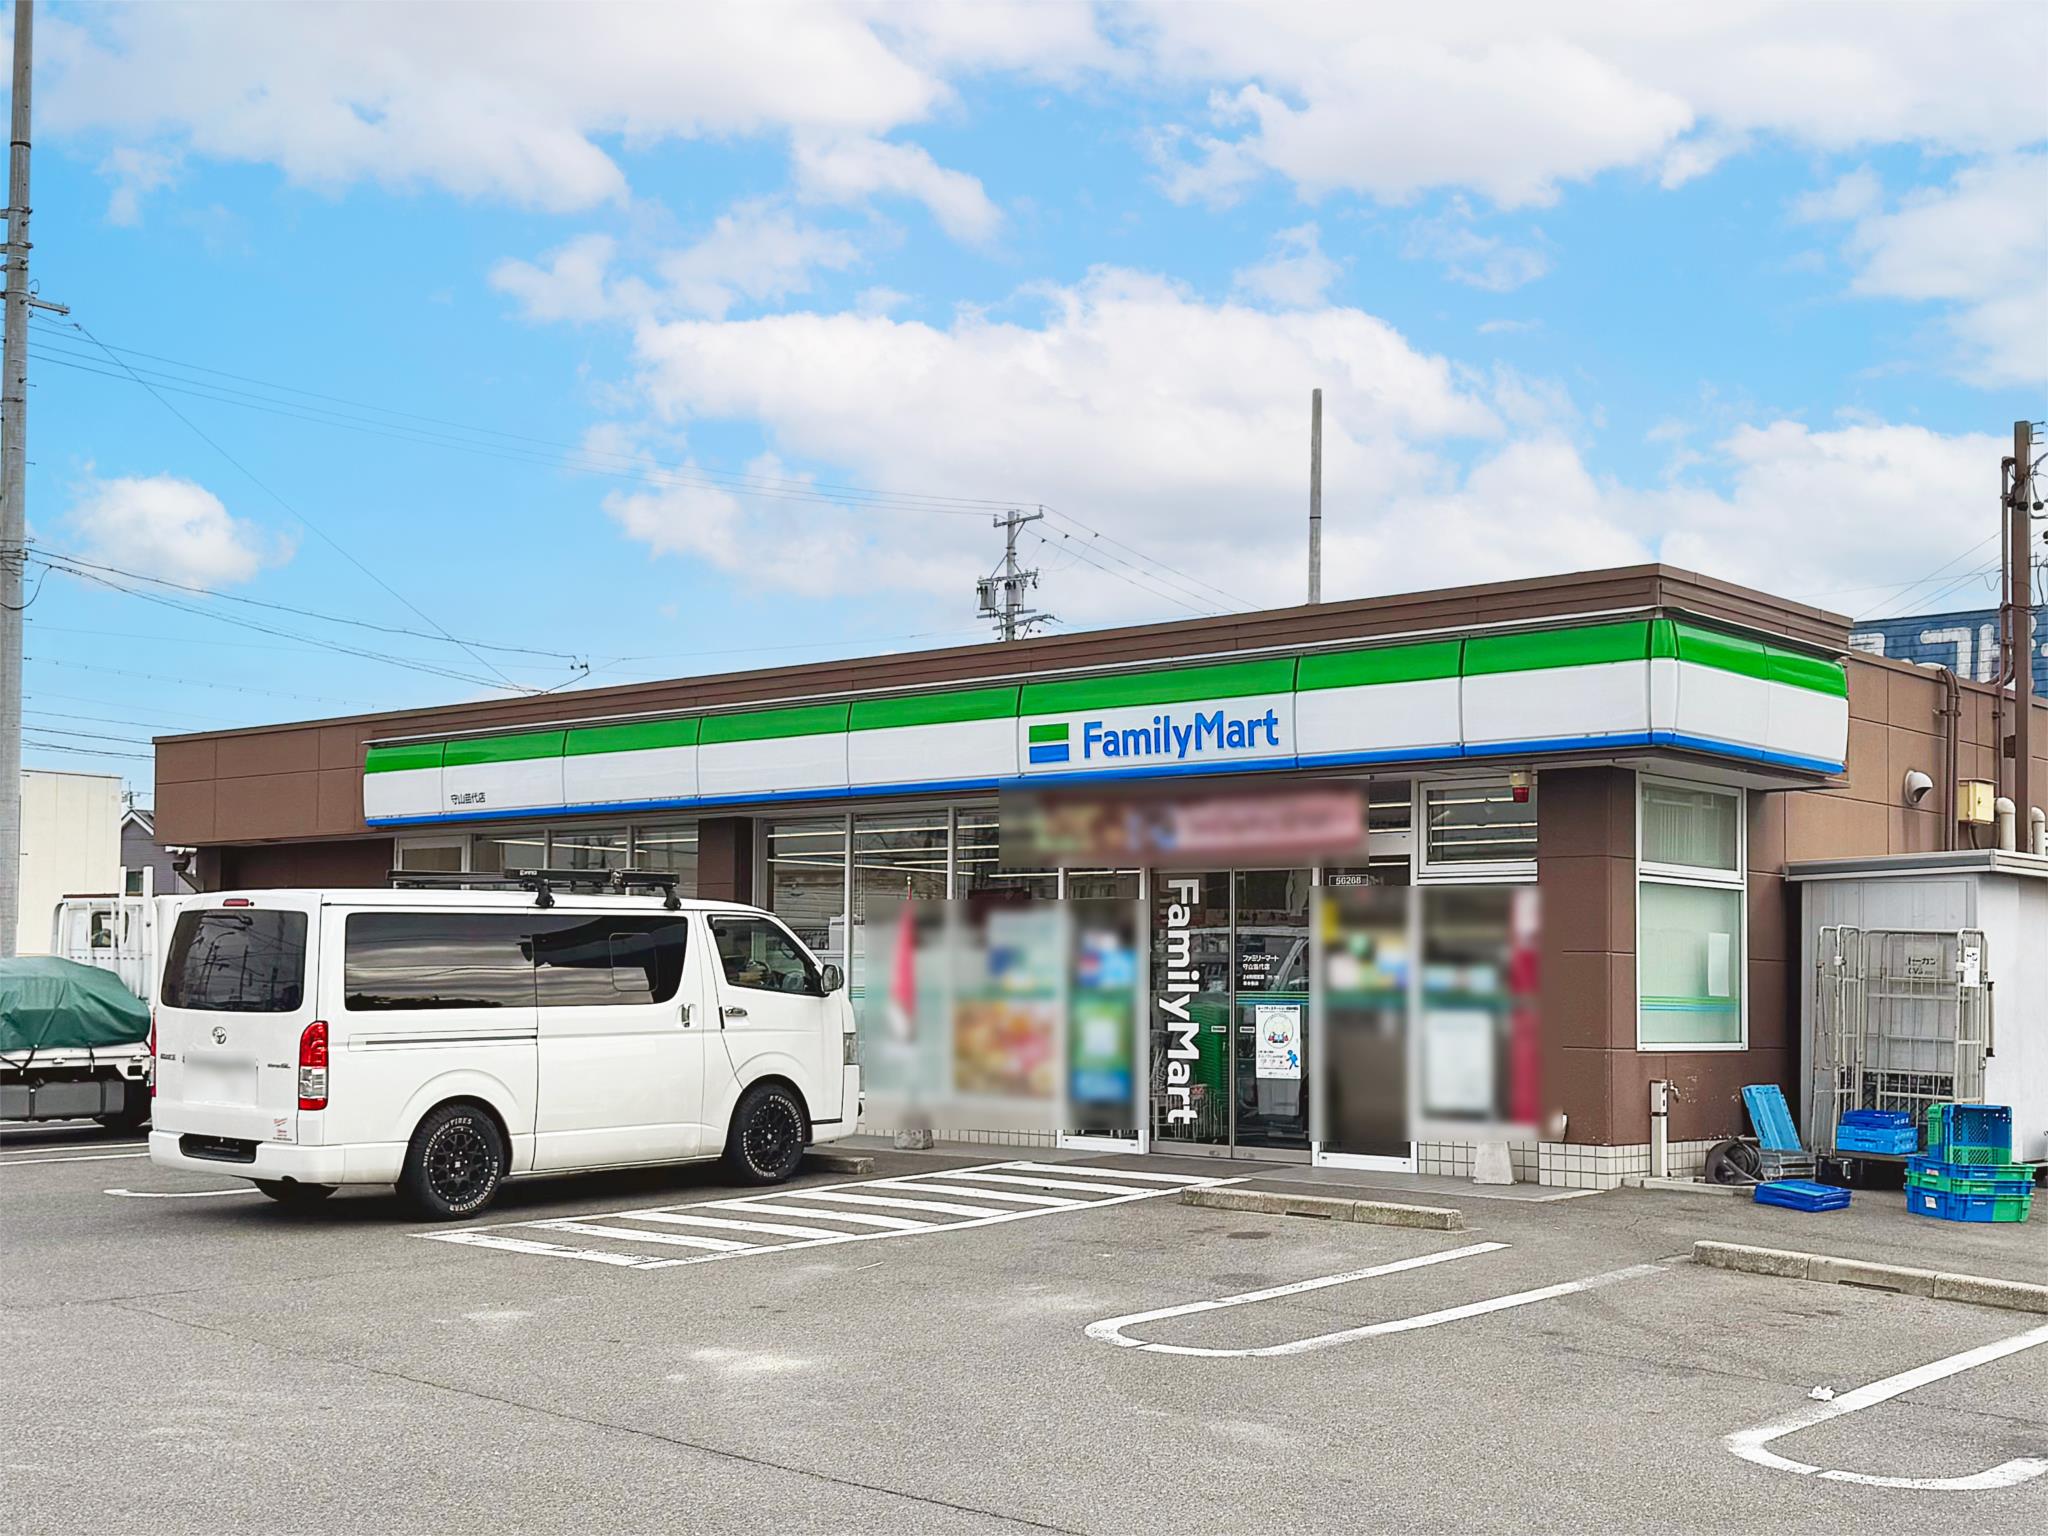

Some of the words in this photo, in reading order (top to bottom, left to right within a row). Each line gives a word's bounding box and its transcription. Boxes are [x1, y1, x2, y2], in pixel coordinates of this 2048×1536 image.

[1083, 708, 1279, 758] FamilyMart
[1242, 954, 1280, 963] ファミリーマート
[1907, 956, 1936, 966] トーカン
[1158, 878, 1200, 1125] FamilyMart
